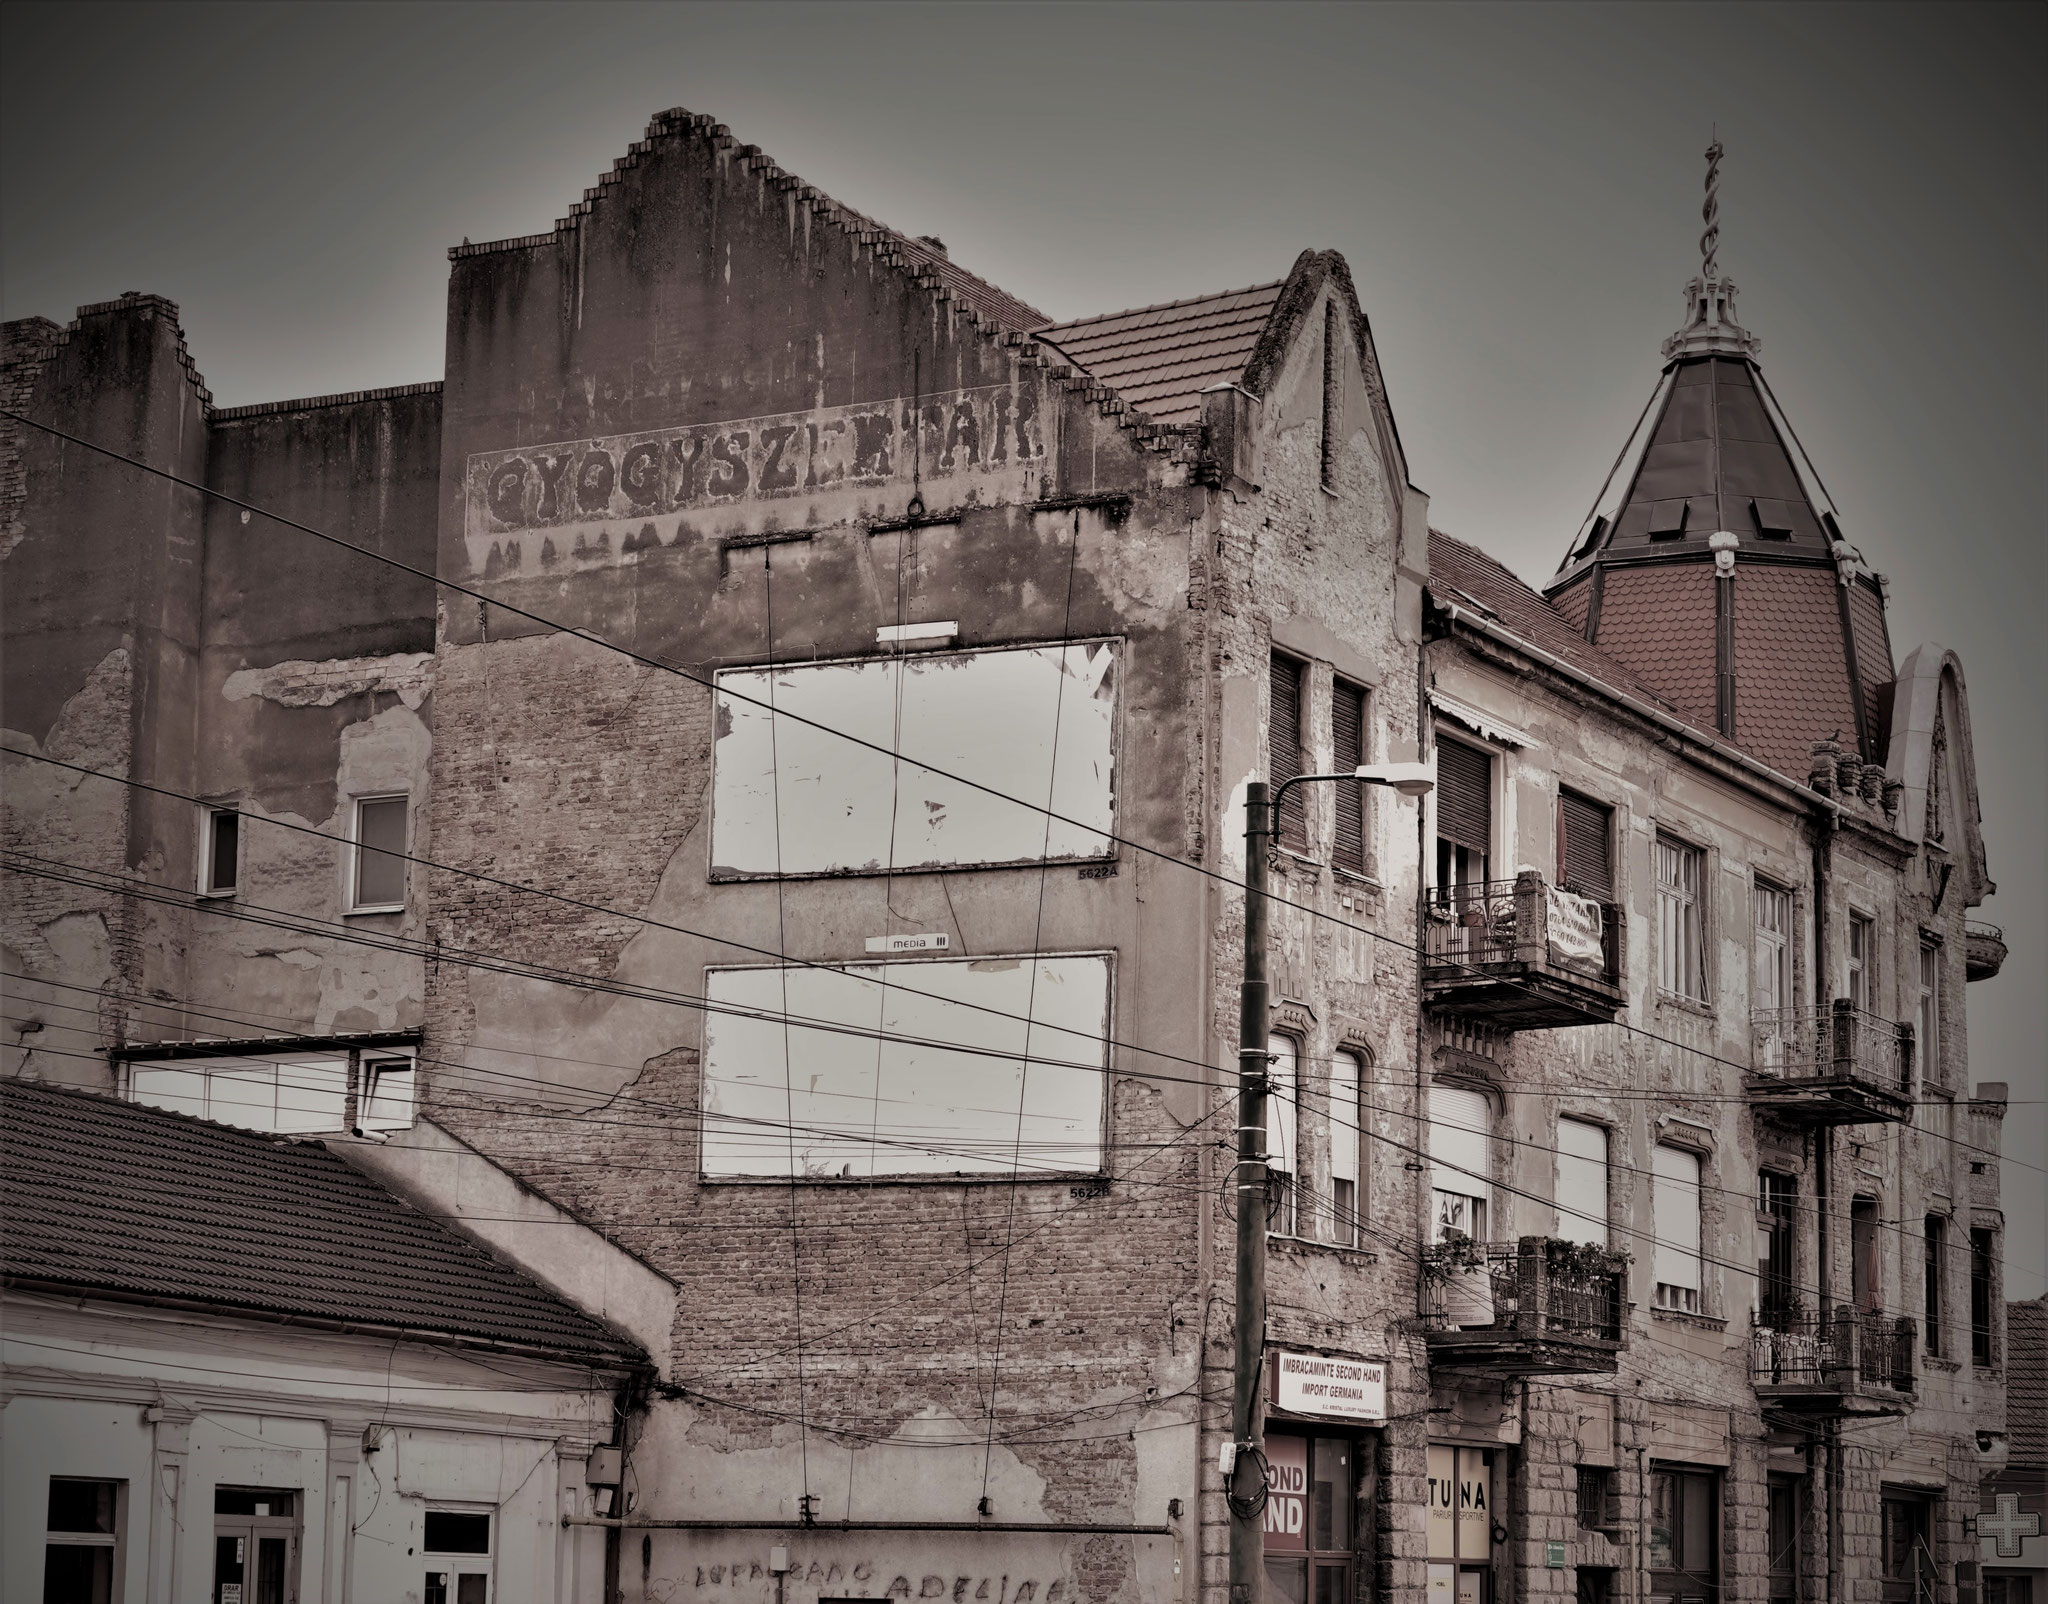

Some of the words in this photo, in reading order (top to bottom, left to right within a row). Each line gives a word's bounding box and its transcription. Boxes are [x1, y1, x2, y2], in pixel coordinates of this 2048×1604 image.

[1079, 867, 1118, 880] 5622A
[1283, 1358, 1334, 1378] IMBRACAMINTE
[1336, 1365, 1361, 1381] SECOND
[1363, 1368, 1381, 1384] HAND
[1302, 1383, 1328, 1398] IMPORT
[1330, 1386, 1363, 1400] GERMANIA
[224, 1584, 239, 1592] ORAR
